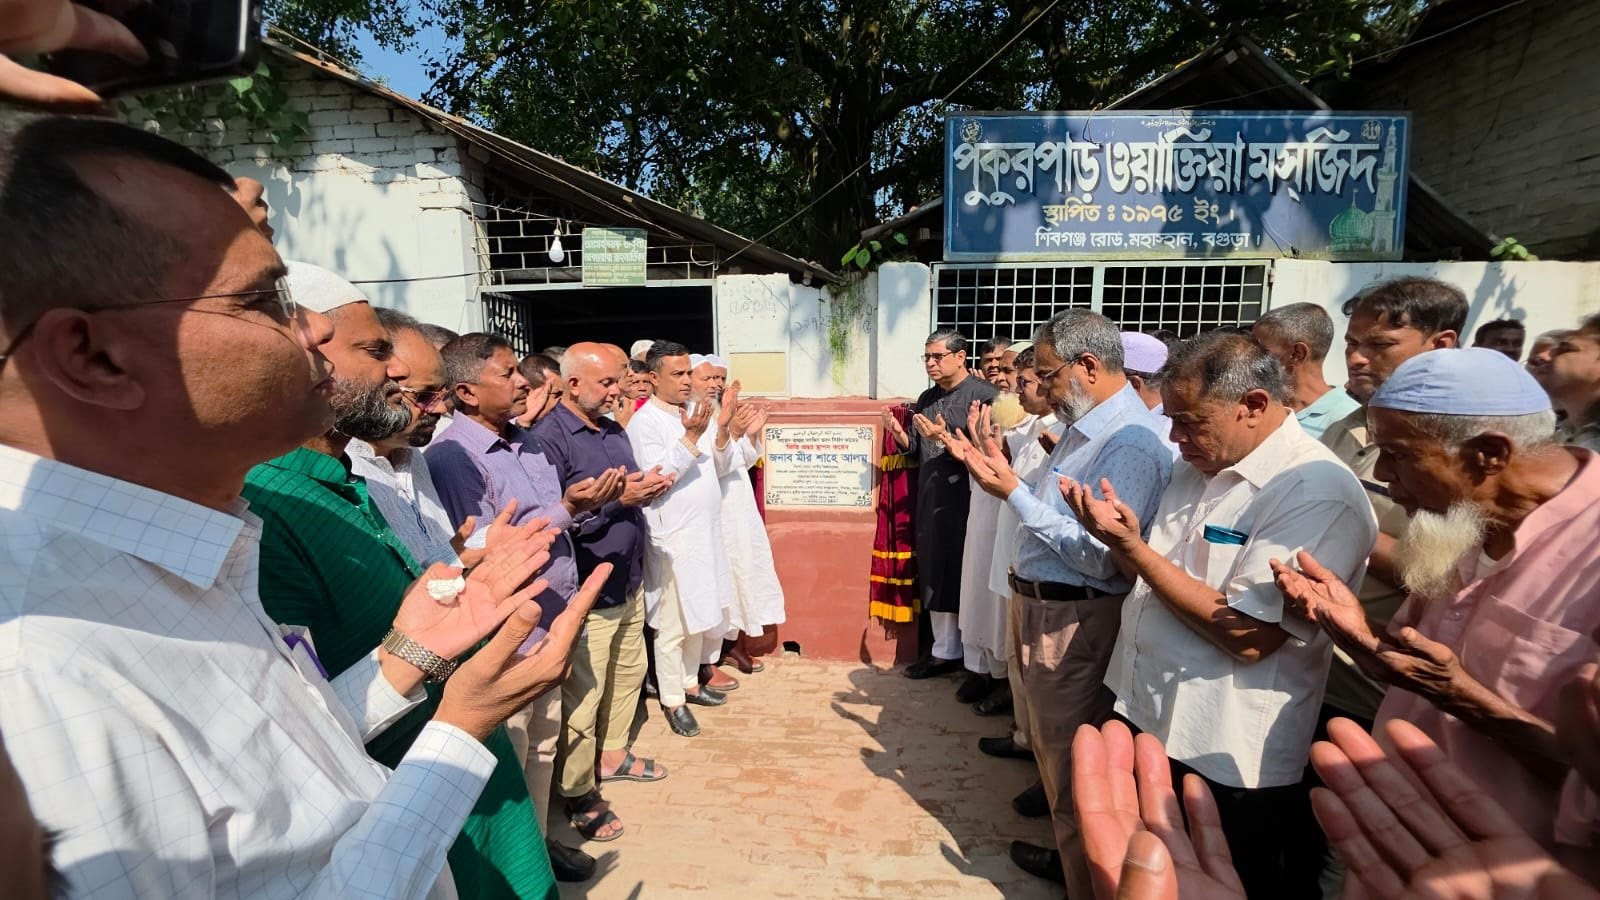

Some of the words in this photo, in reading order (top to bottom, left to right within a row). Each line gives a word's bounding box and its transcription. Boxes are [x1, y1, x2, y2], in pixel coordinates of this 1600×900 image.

[953, 131, 1102, 206] পুকুরপাড়
[1106, 126, 1245, 194] ওয়াক্তিয়া
[1042, 197, 1101, 227] স্থাপিত
[1122, 204, 1184, 223] ১৯৭৫
[1035, 226, 1087, 247] শিবগঞ্জ
[768, 453, 792, 463] জনাব
[795, 450, 812, 462] মীর
[816, 453, 839, 463] শাহে
